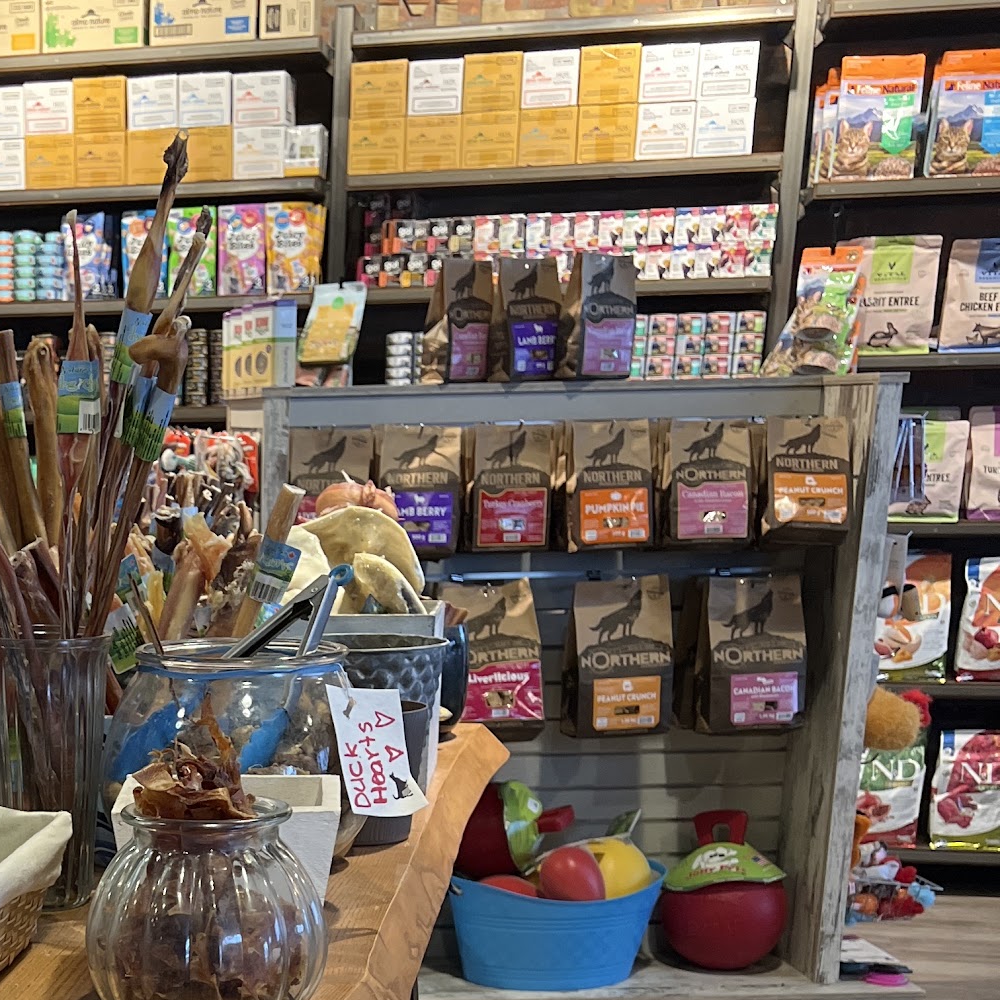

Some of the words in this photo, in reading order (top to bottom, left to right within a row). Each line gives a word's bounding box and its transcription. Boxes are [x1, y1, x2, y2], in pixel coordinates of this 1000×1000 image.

[856, 84, 882, 94] Feline
[882, 84, 916, 93] Natural
[956, 81, 981, 90] Feline
[888, 296, 920, 306] ENTREE
[979, 292, 997, 301] BEEF
[960, 302, 992, 312] CHICKEN
[776, 457, 839, 470] NORTHERN
[386, 472, 449, 485] NORTHERN
[480, 472, 541, 485] NORTHERN
[583, 470, 642, 483] NORTHERN
[676, 467, 746, 481] NORTHERN
[681, 489, 718, 498] Canadian
[720, 488, 744, 498] Bacon
[778, 486, 809, 494] PEANUT
[810, 486, 844, 494] CRUNCH
[398, 508, 414, 518] AMB
[416, 506, 447, 517] BERRY
[585, 503, 629, 515] PUMPKIN
[630, 502, 644, 512] PIE
[469, 648, 538, 665] ORTHERN
[581, 650, 671, 668] NORTHERN
[714, 648, 804, 664] NORTHERN
[468, 671, 530, 684] Liverlicious
[733, 685, 771, 696] CANADIAN
[598, 693, 626, 704] PEANUT
[627, 692, 656, 701] CRUNCH
[358, 722, 388, 804] Hearts
